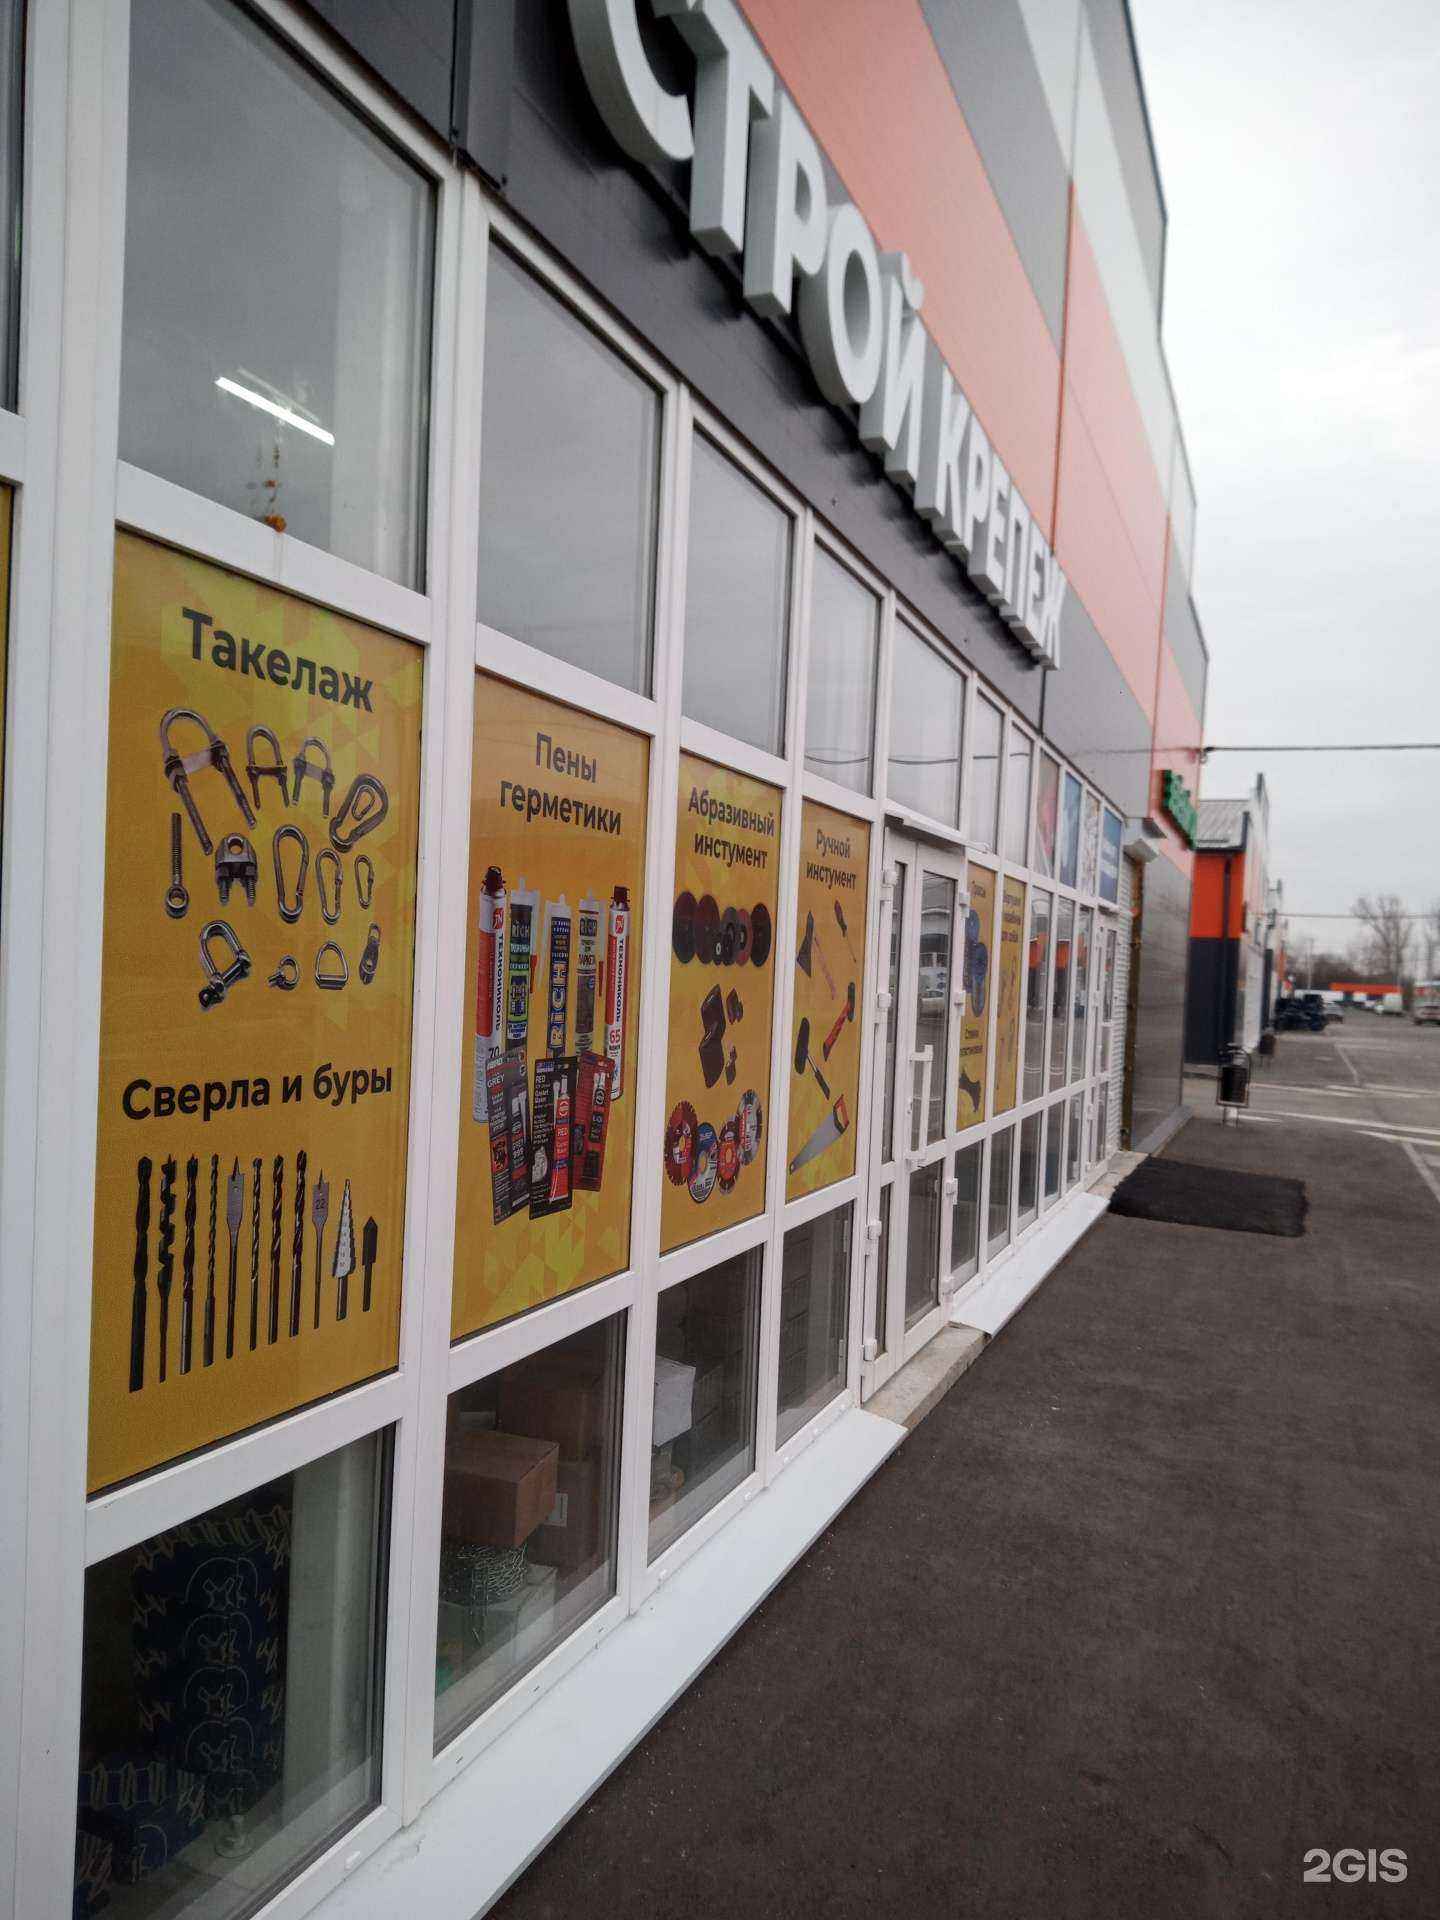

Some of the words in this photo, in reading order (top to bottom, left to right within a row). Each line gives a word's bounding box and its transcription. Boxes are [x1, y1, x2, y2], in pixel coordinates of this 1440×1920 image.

[181, 606, 374, 713] Такелаж
[535, 731, 597, 784] Пены
[500, 780, 622, 836] герметики
[688, 786, 775, 838] Абразивный
[694, 832, 768, 869] инстумент
[816, 828, 851, 860] Ручной
[806, 861, 857, 891] инстумент
[616, 938, 625, 1023] ТЕХНОНИКОЛЬ
[488, 1046, 500, 1058] 70
[609, 1028, 621, 1044] 65
[122, 1074, 271, 1122] Сверла
[281, 1075, 303, 1104] и
[312, 1062, 392, 1107] буры
[487, 1072, 505, 1088] GREY
